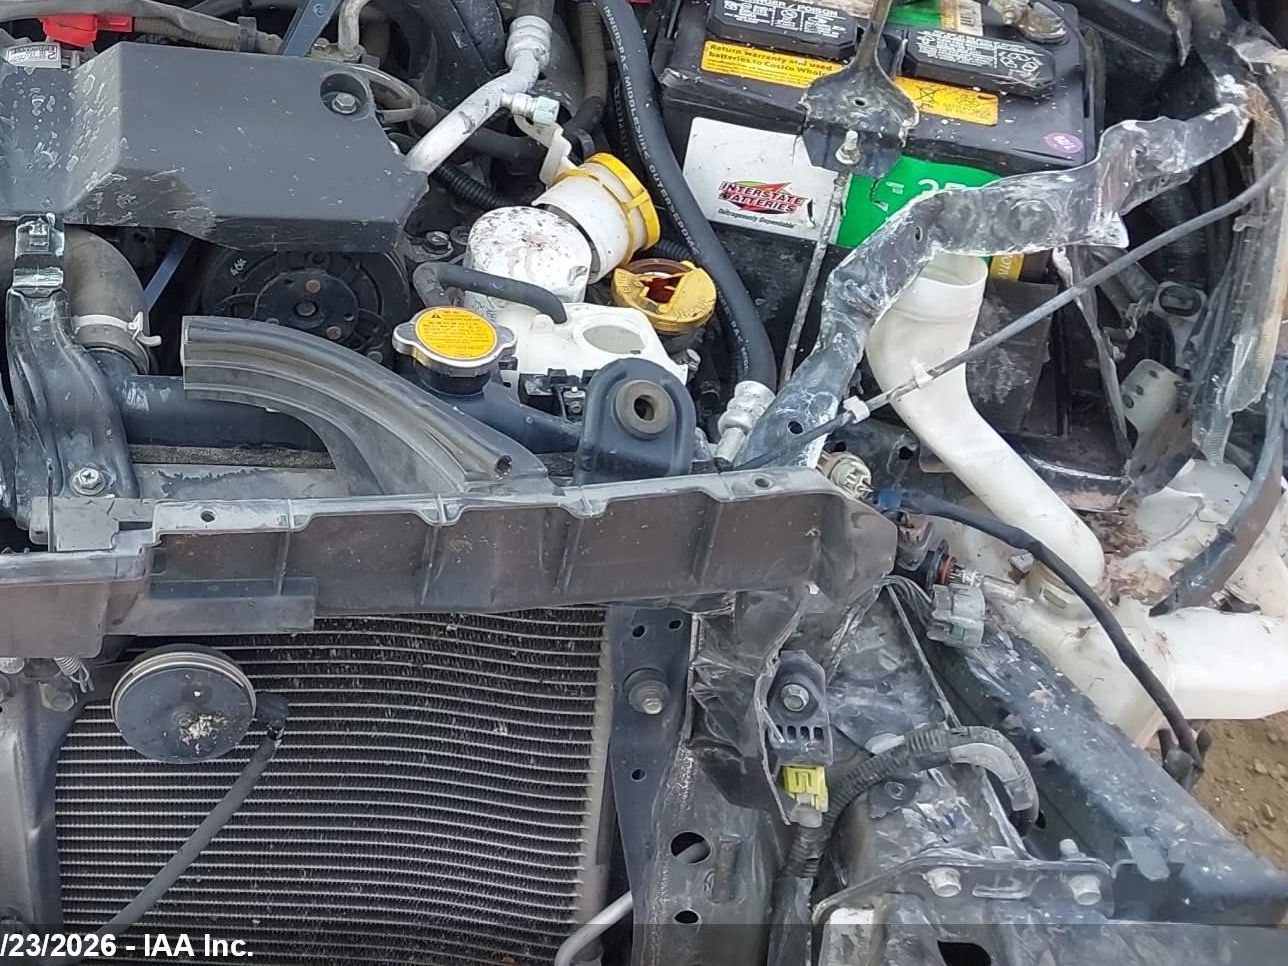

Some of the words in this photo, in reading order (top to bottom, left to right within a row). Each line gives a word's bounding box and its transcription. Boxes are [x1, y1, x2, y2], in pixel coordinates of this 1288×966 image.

[797, 4, 838, 18] POISON
[708, 51, 750, 64] batteries
[753, 58, 763, 66] to
[764, 60, 795, 73] Costco
[710, 44, 742, 55] Return
[744, 50, 787, 66] warranty
[789, 57, 808, 67] and
[810, 61, 833, 72] used
[718, 180, 805, 205] INTERSTATE
[718, 192, 797, 212] BATTERIES
